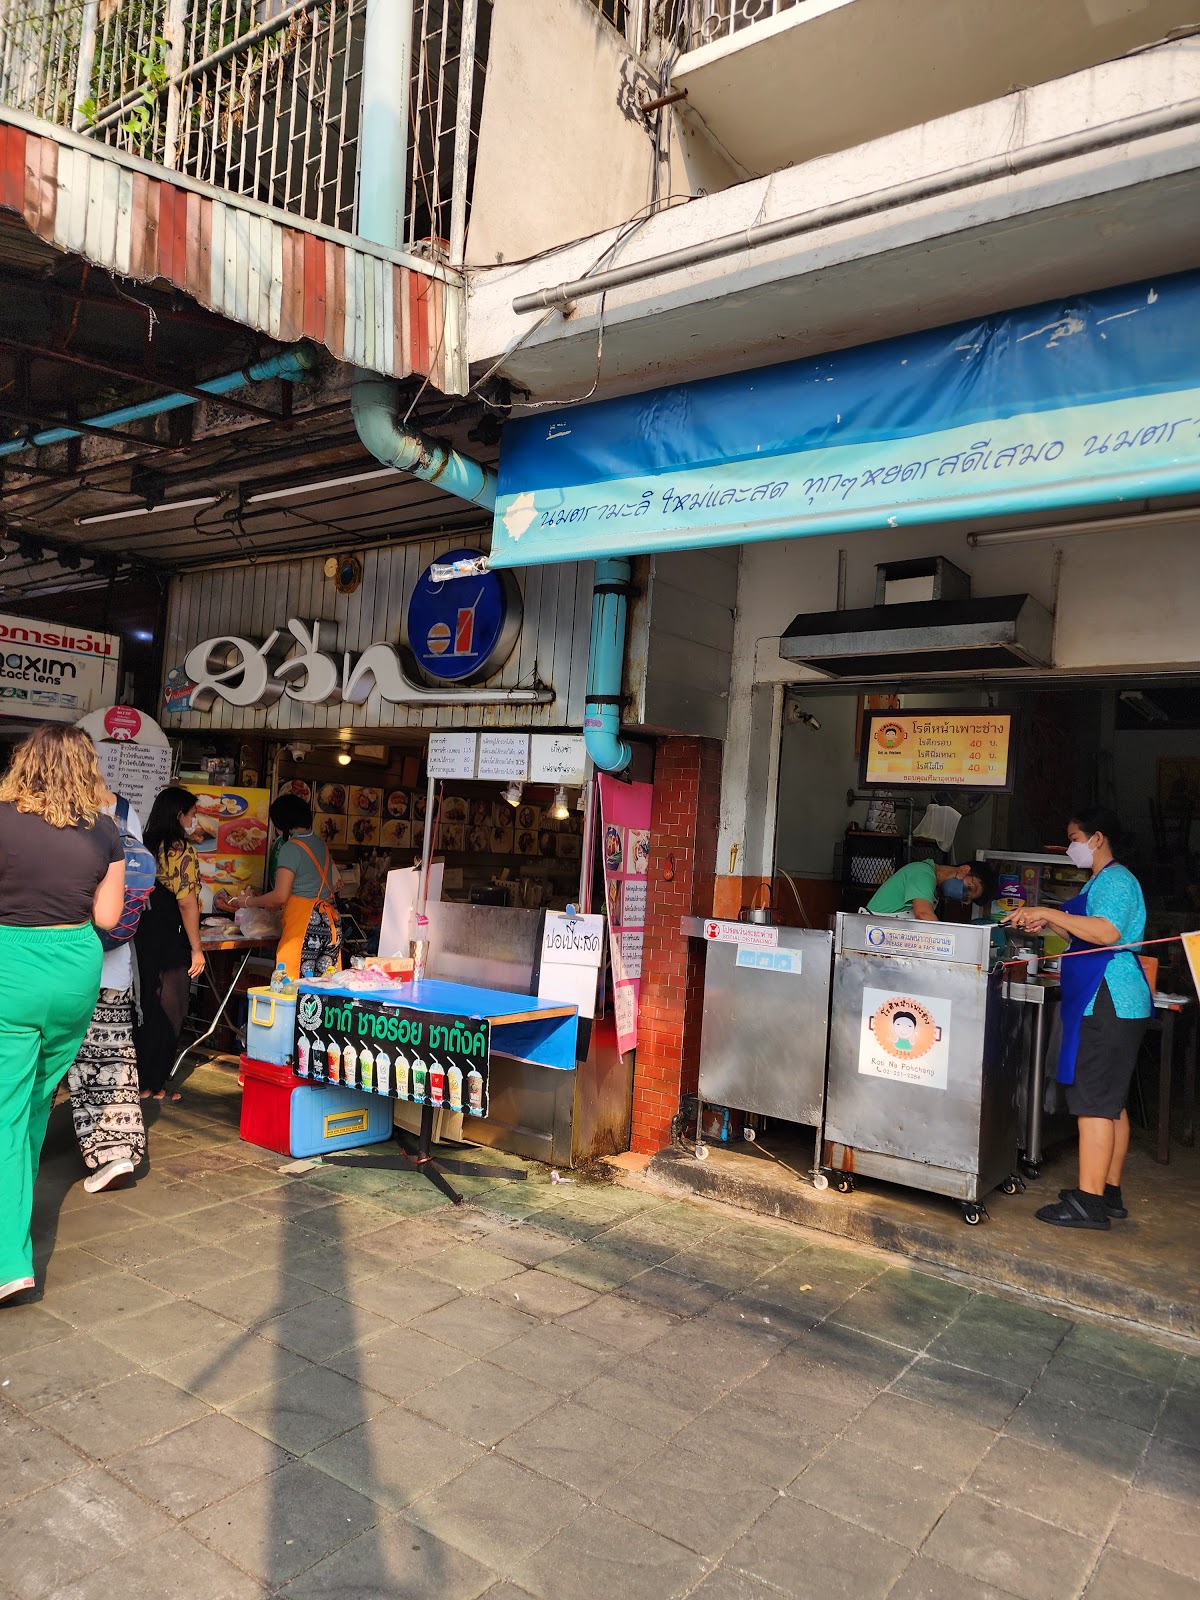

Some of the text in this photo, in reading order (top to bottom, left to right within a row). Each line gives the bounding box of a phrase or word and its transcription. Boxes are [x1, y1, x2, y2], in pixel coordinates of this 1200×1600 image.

[540, 490, 654, 527] นมตรามะลิ
[662, 481, 789, 514] ใหม่และสด
[1084, 418, 1200, 456] นมตร
[34, 672, 61, 685] lens
[969, 739, 982, 747] 40
[968, 752, 981, 760] 40
[968, 764, 980, 772] 40
[742, 936, 772, 945] DISTANCING
[886, 940, 903, 948] PLEASE
[324, 1001, 353, 1033] ชาดี
[357, 1008, 423, 1046] ชาอร่อย
[871, 1057, 885, 1066] Roti
[889, 1061, 898, 1069] Na
